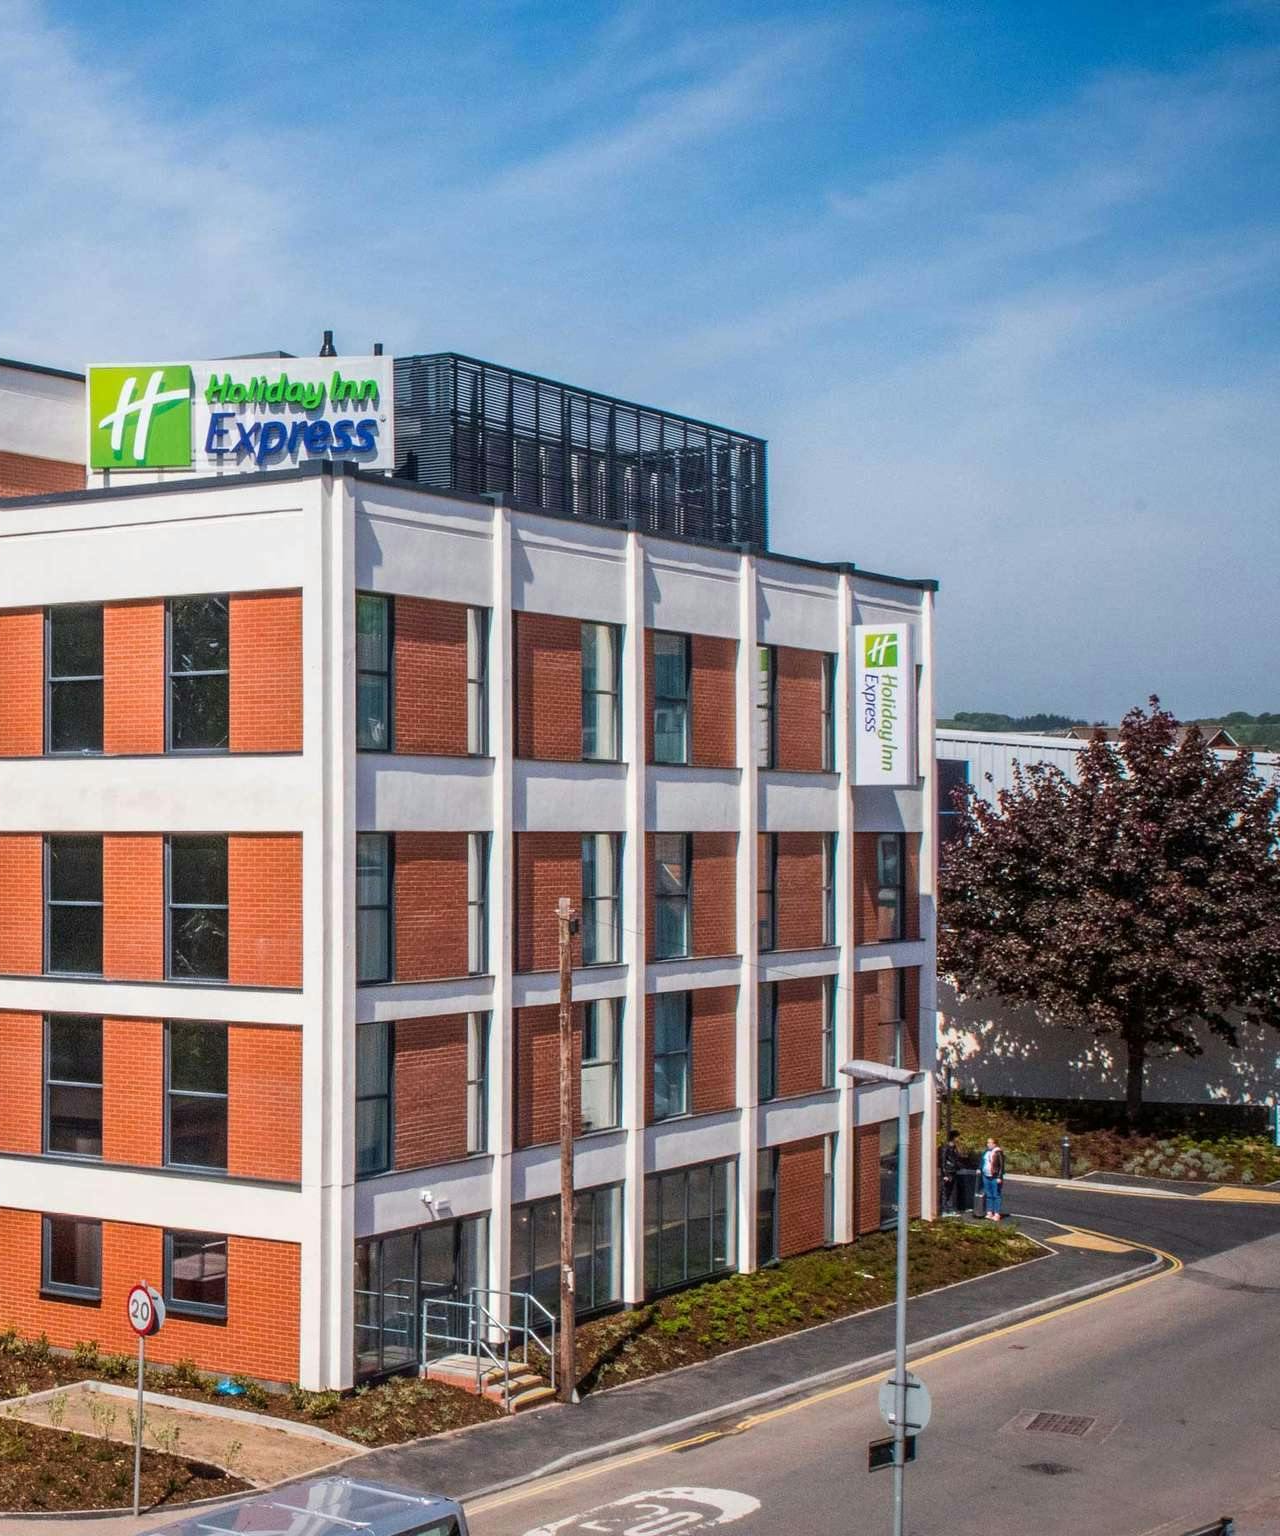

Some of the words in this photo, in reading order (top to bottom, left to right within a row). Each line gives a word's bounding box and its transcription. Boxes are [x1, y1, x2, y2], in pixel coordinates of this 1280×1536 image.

[205, 372, 325, 411] Holiday
[330, 370, 379, 402] Inn
[204, 411, 380, 465] Express
[861, 673, 879, 733] Express
[877, 673, 898, 740] Holiday
[881, 745, 898, 772] Inn
[132, 1299, 149, 1321] 20
